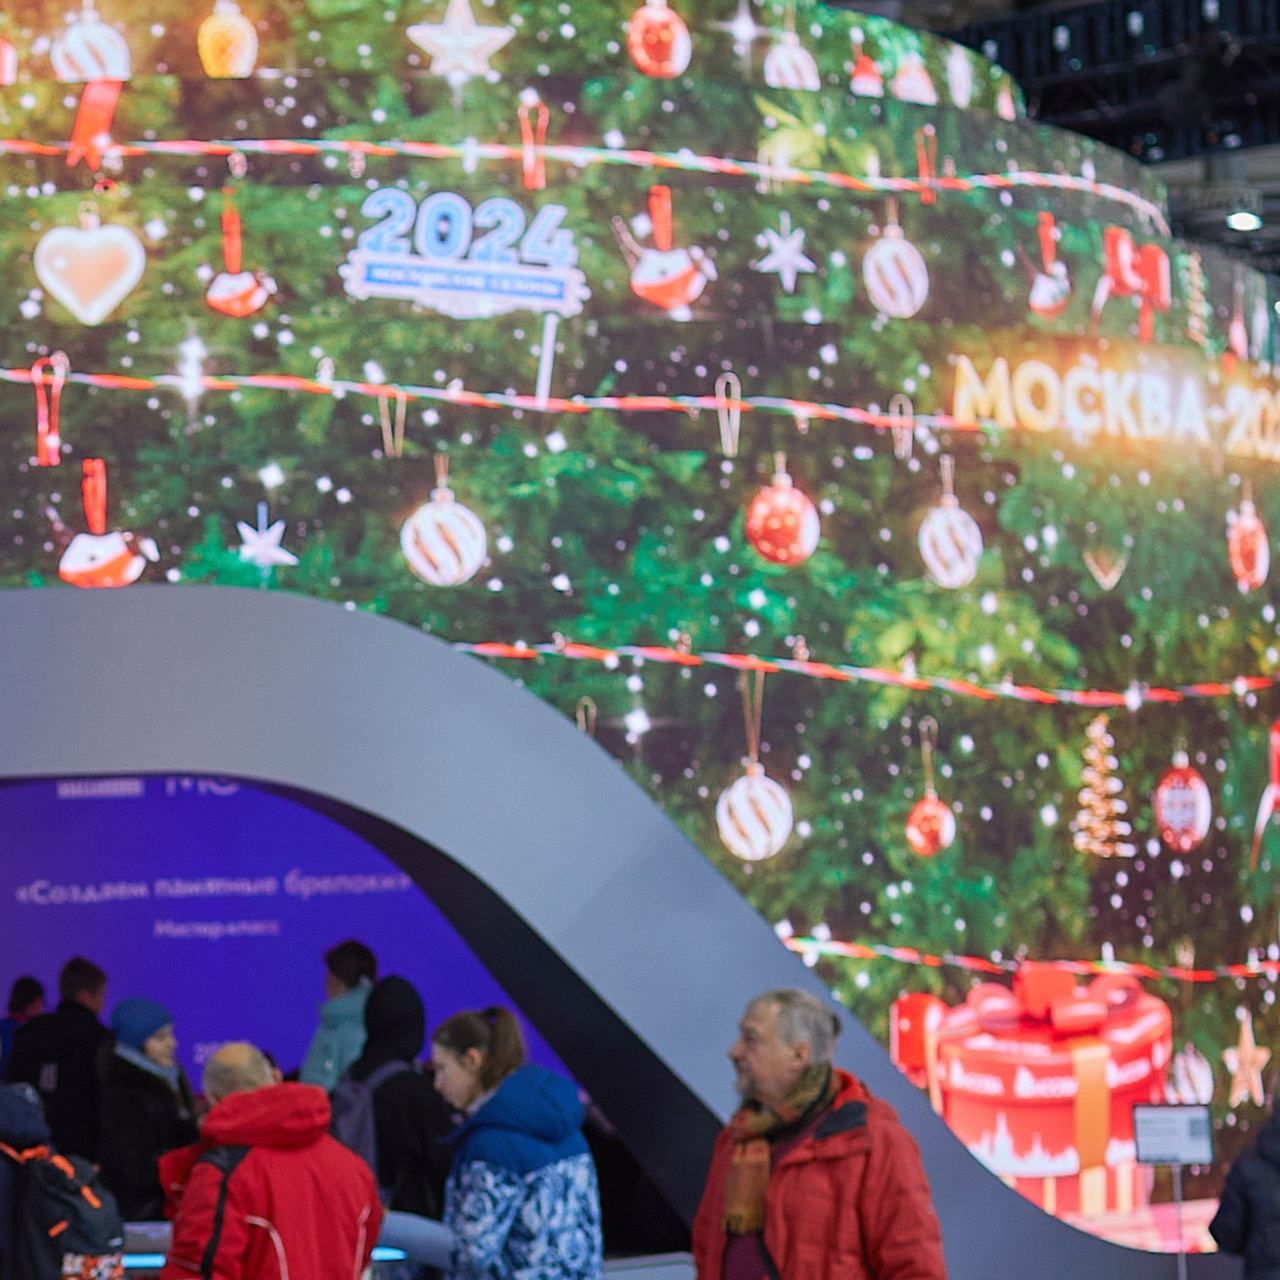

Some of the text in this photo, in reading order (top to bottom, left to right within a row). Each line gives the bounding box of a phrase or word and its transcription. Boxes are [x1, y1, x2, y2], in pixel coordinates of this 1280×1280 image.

[357, 186, 579, 268] 2024
[953, 354, 1280, 461] МОСКВА 20
